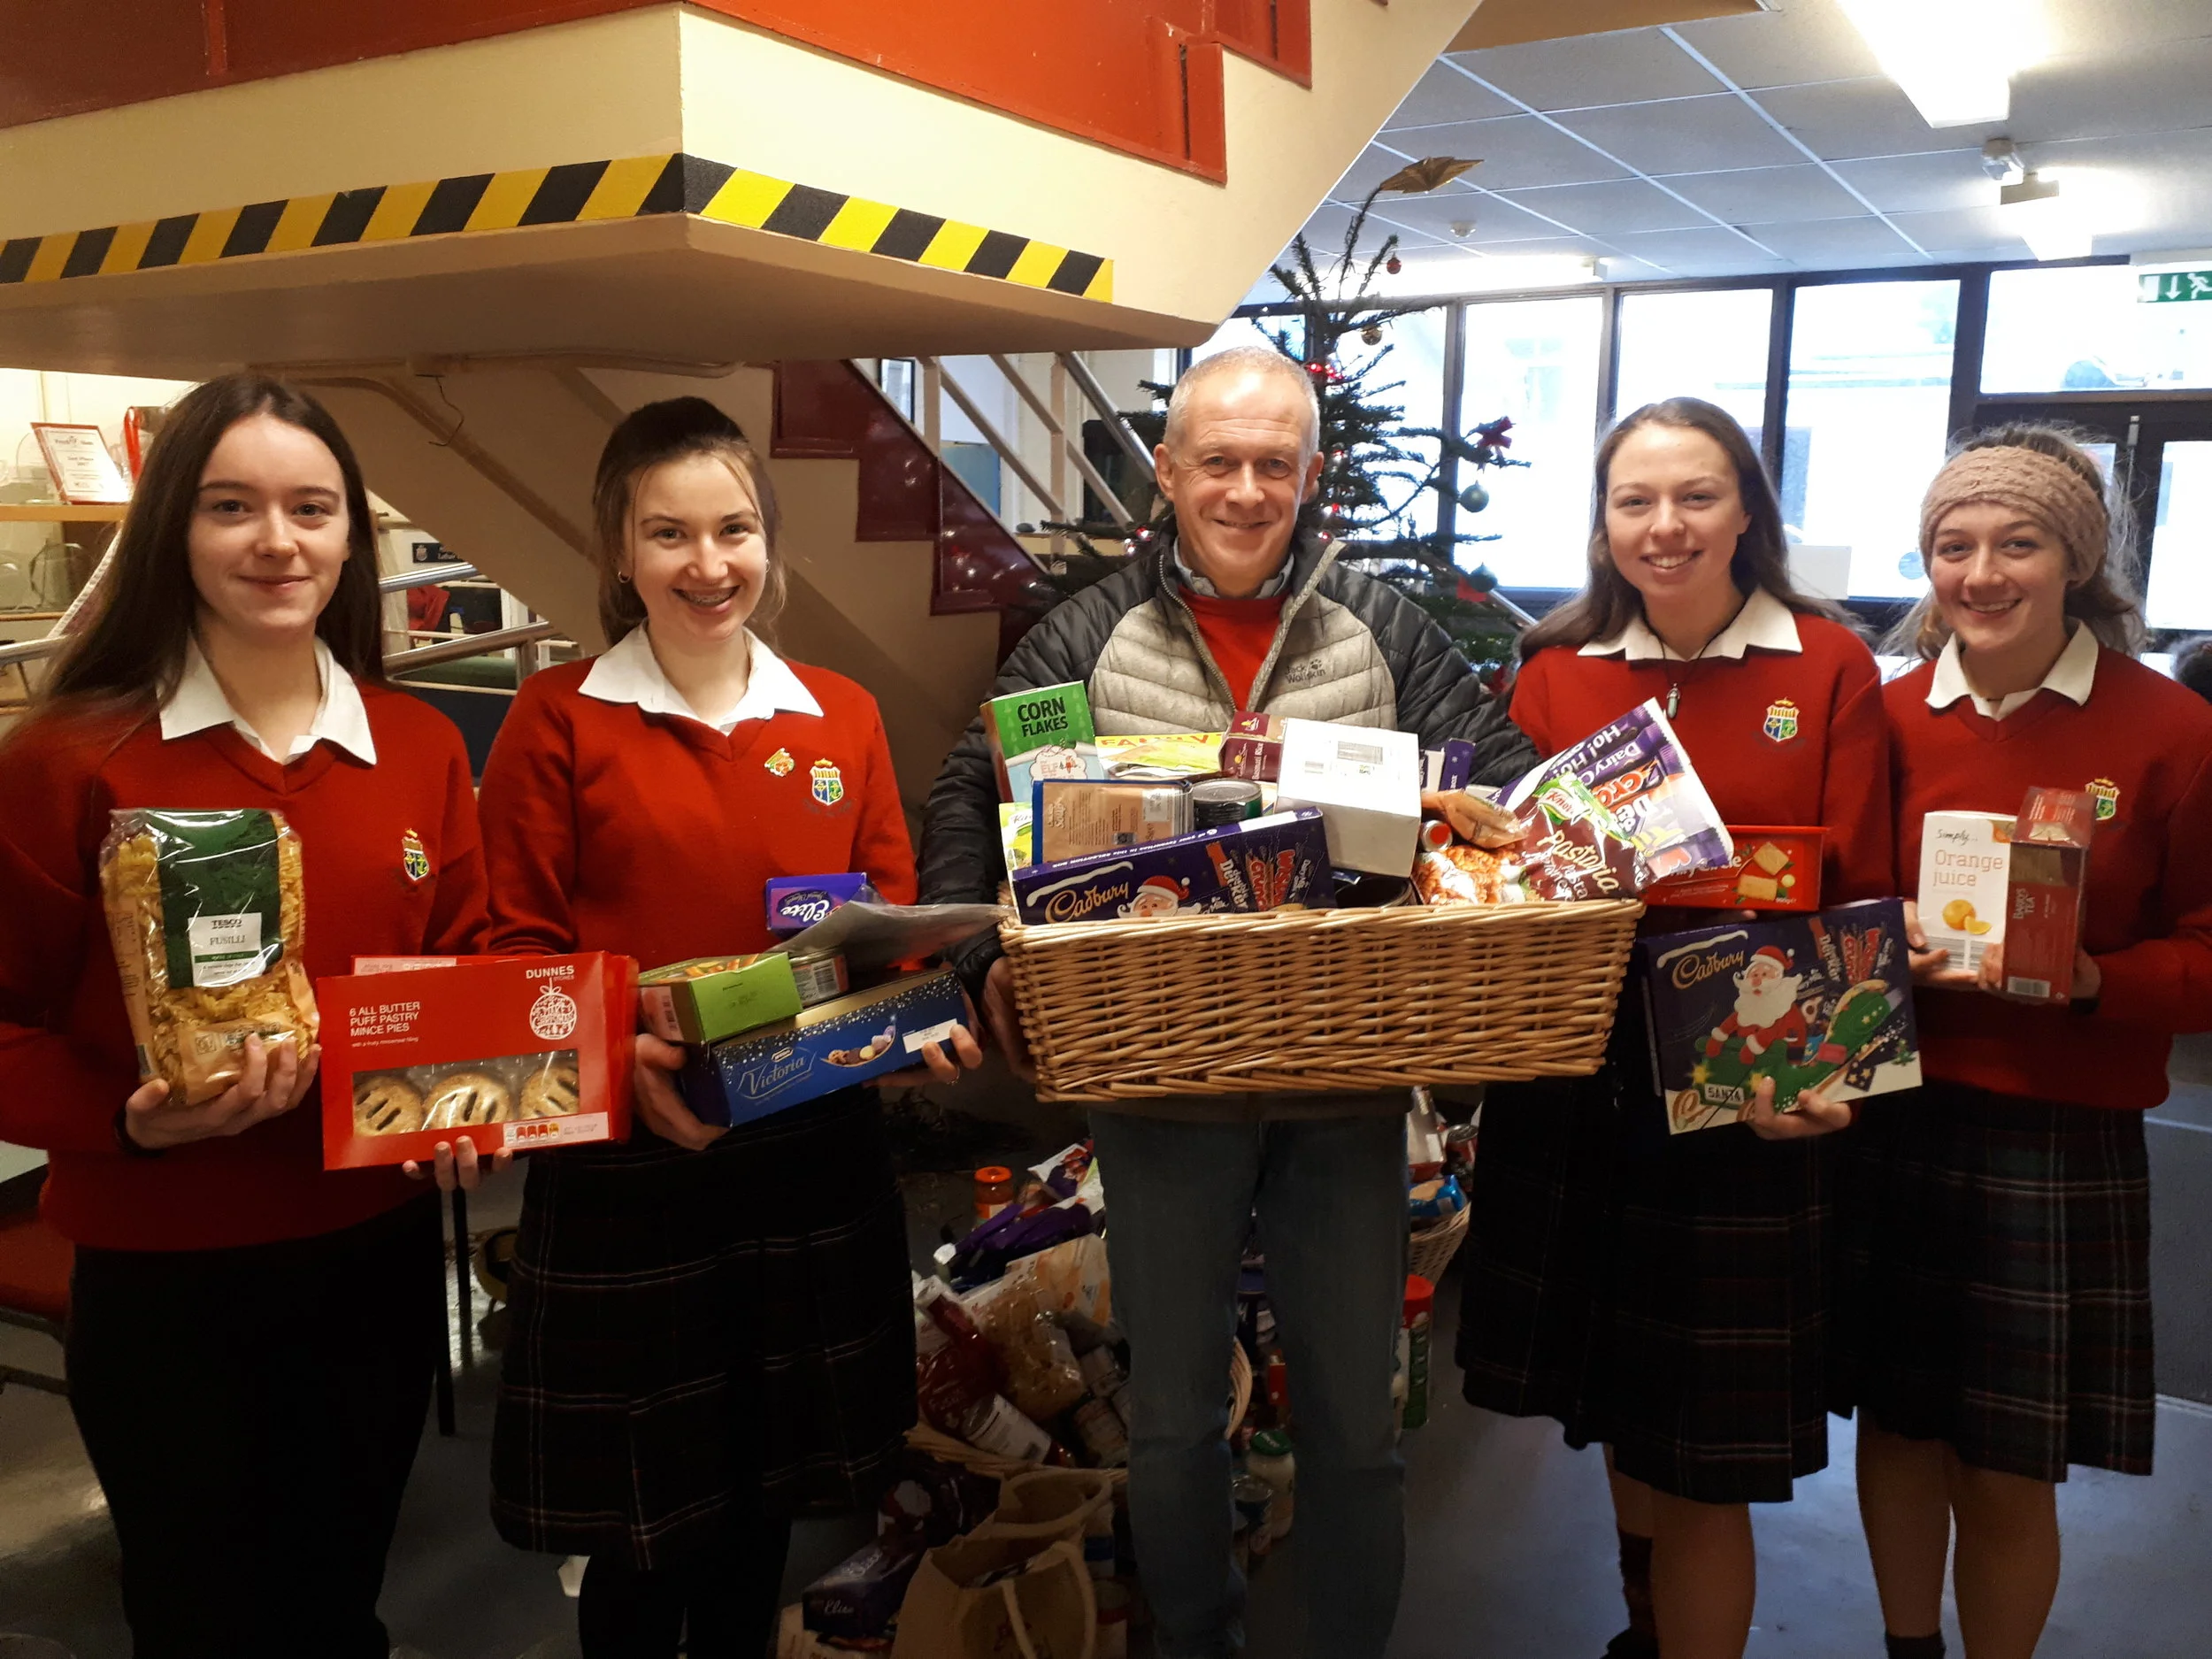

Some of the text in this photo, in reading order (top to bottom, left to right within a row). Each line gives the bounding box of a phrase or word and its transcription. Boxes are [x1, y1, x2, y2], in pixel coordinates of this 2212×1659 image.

[1017, 695, 1066, 723] CORN
[1021, 715, 1069, 738] FLAKES
[1595, 741, 1642, 774] Dairy
[1547, 791, 1576, 816] Knor
[1935, 849, 2004, 872] Orange
[780, 899, 830, 922] Elite
[1044, 881, 1129, 924] Cadbury
[211, 918, 242, 929] TESCO
[210, 934, 246, 946] FUSILLI
[526, 964, 575, 979] DUNNES
[1671, 949, 1745, 990] Cadbury
[349, 1001, 421, 1017] 6 ALL BUTTER
[349, 1010, 419, 1027] PUFF PASTRY
[349, 1022, 411, 1038] MINCE PIES
[745, 1056, 805, 1095] Victoria
